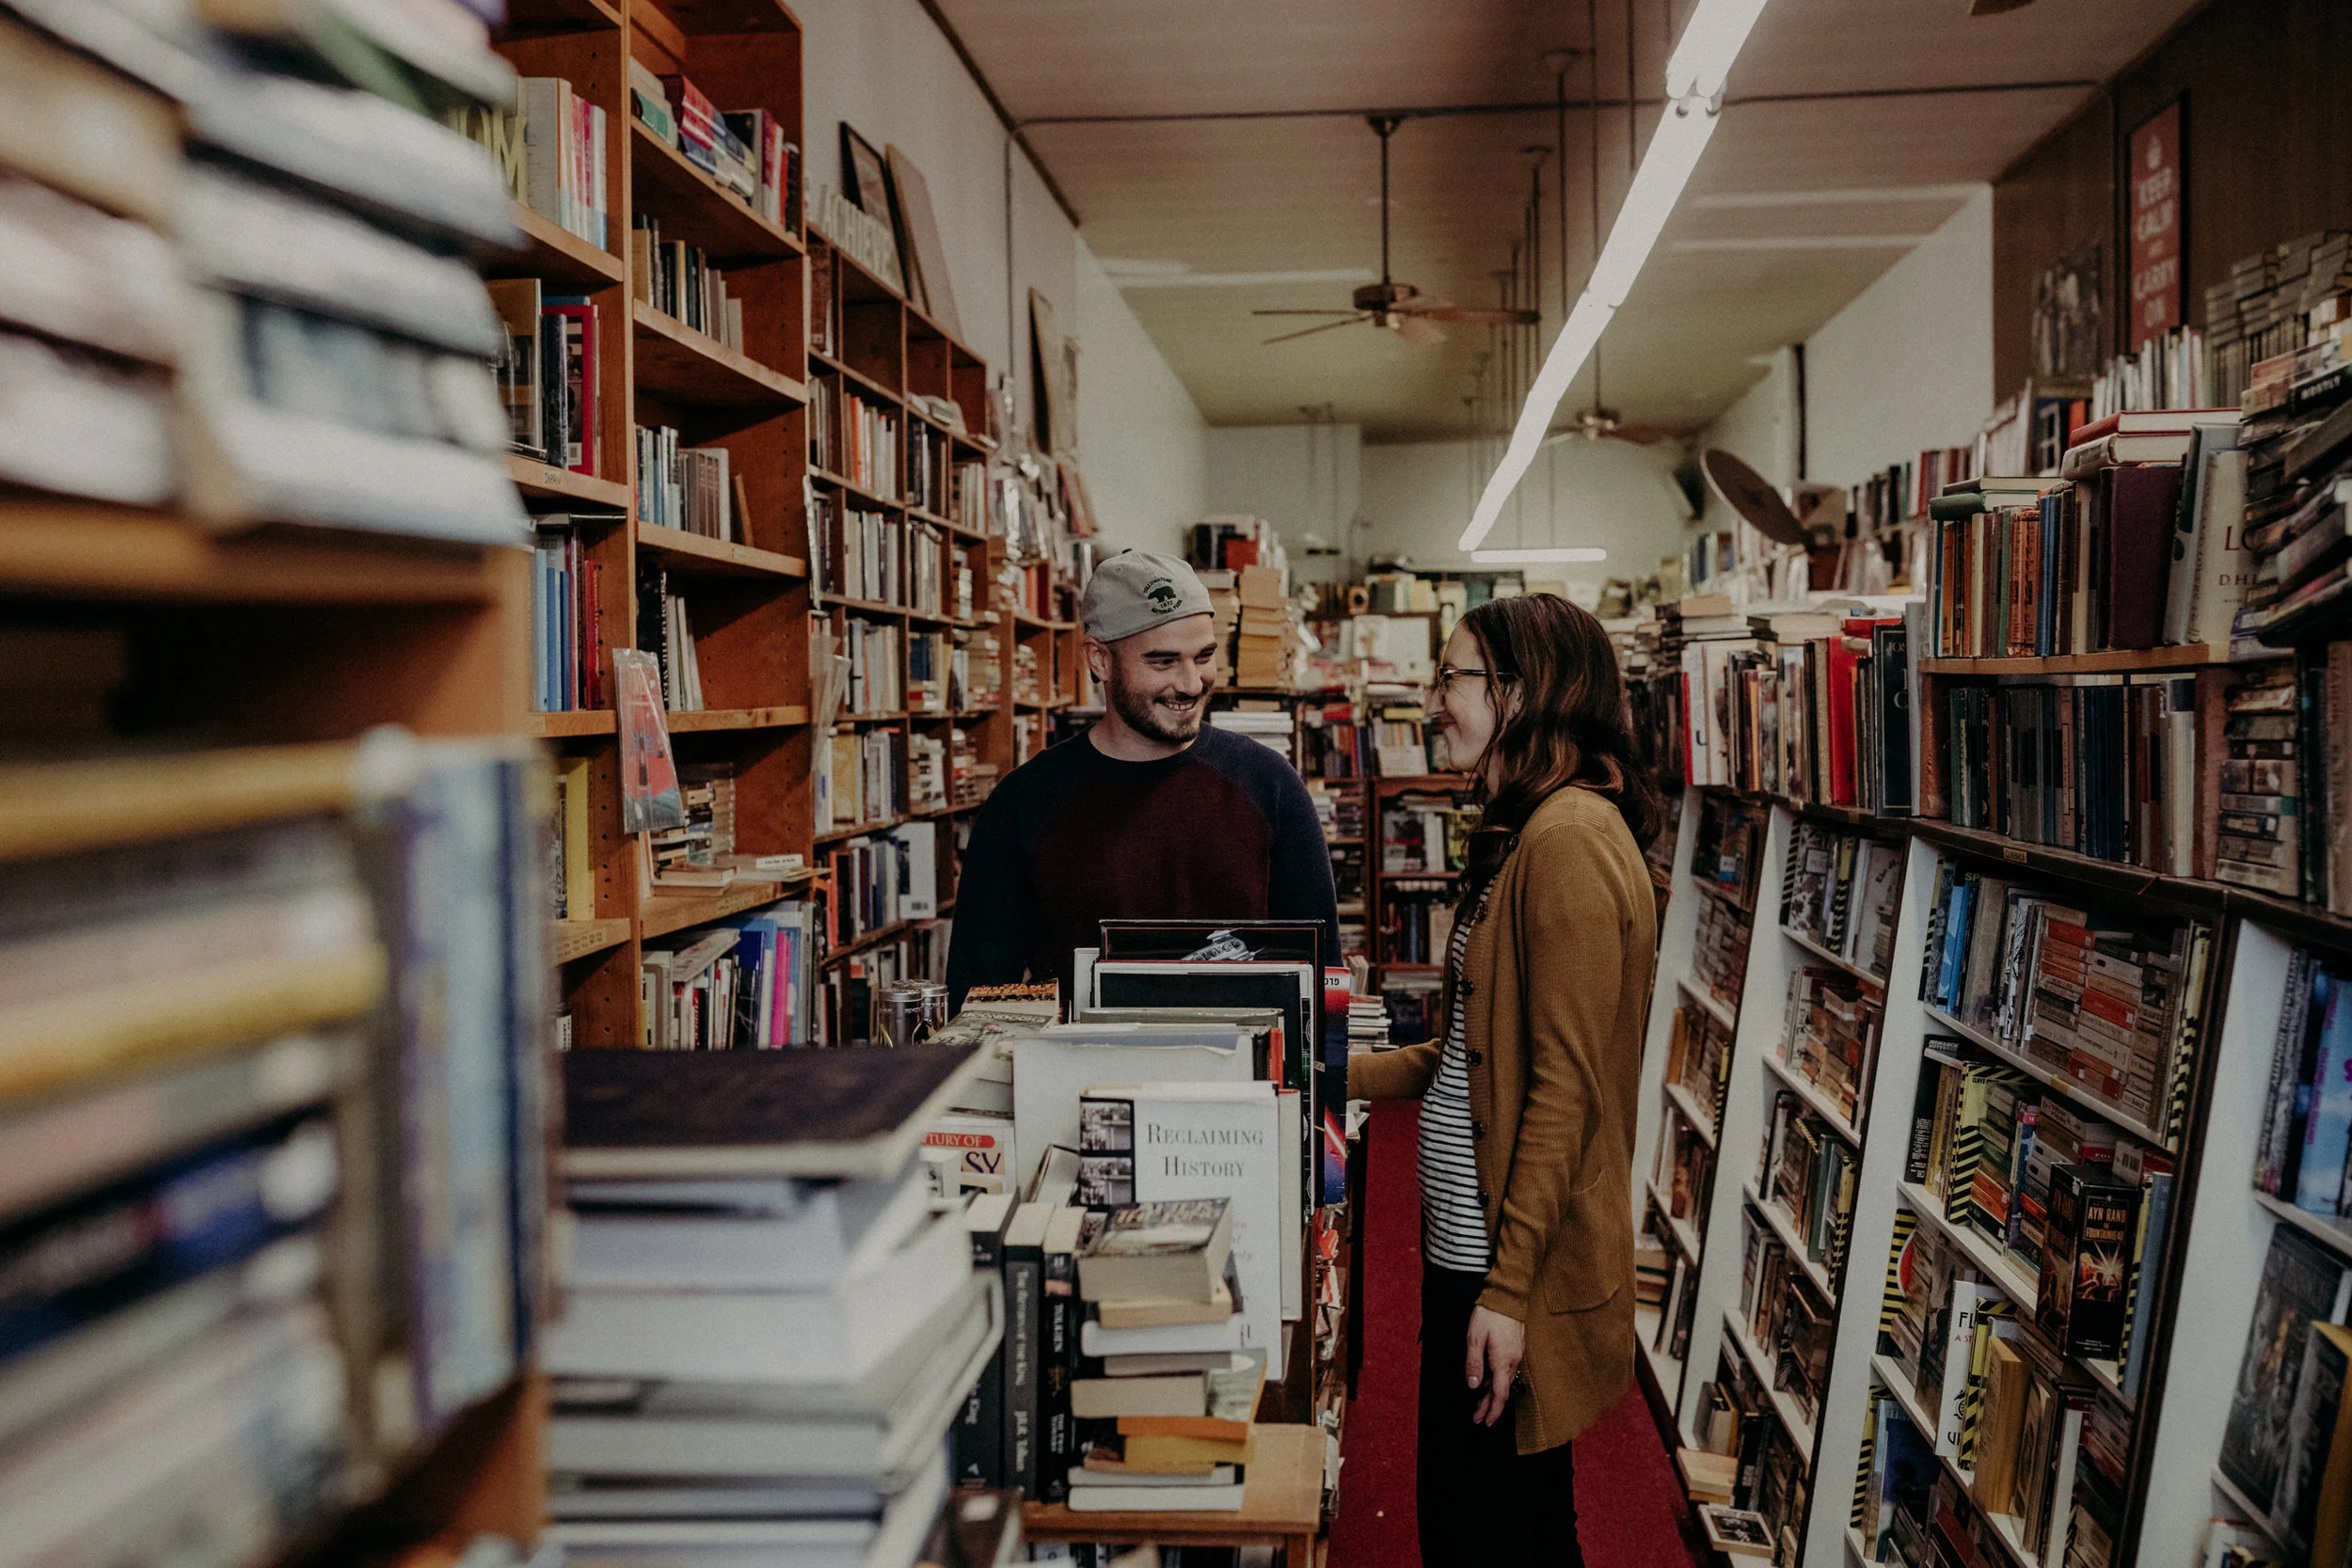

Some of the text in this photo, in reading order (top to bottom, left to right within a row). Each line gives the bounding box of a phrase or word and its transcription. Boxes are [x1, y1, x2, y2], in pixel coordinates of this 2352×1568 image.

[2138, 166, 2172, 209] KEEP
[2137, 198, 2174, 244] CALM
[2133, 257, 2176, 301] CARRY
[2144, 297, 2166, 328] ON
[1151, 607, 1174, 615] NATIONAL
[962, 1135, 982, 1147] OF
[964, 1151, 1002, 1174] SY
[2087, 1206, 2127, 1224] AYN RAND
[2085, 1227, 2124, 1242] FOUNTAINHEAD
